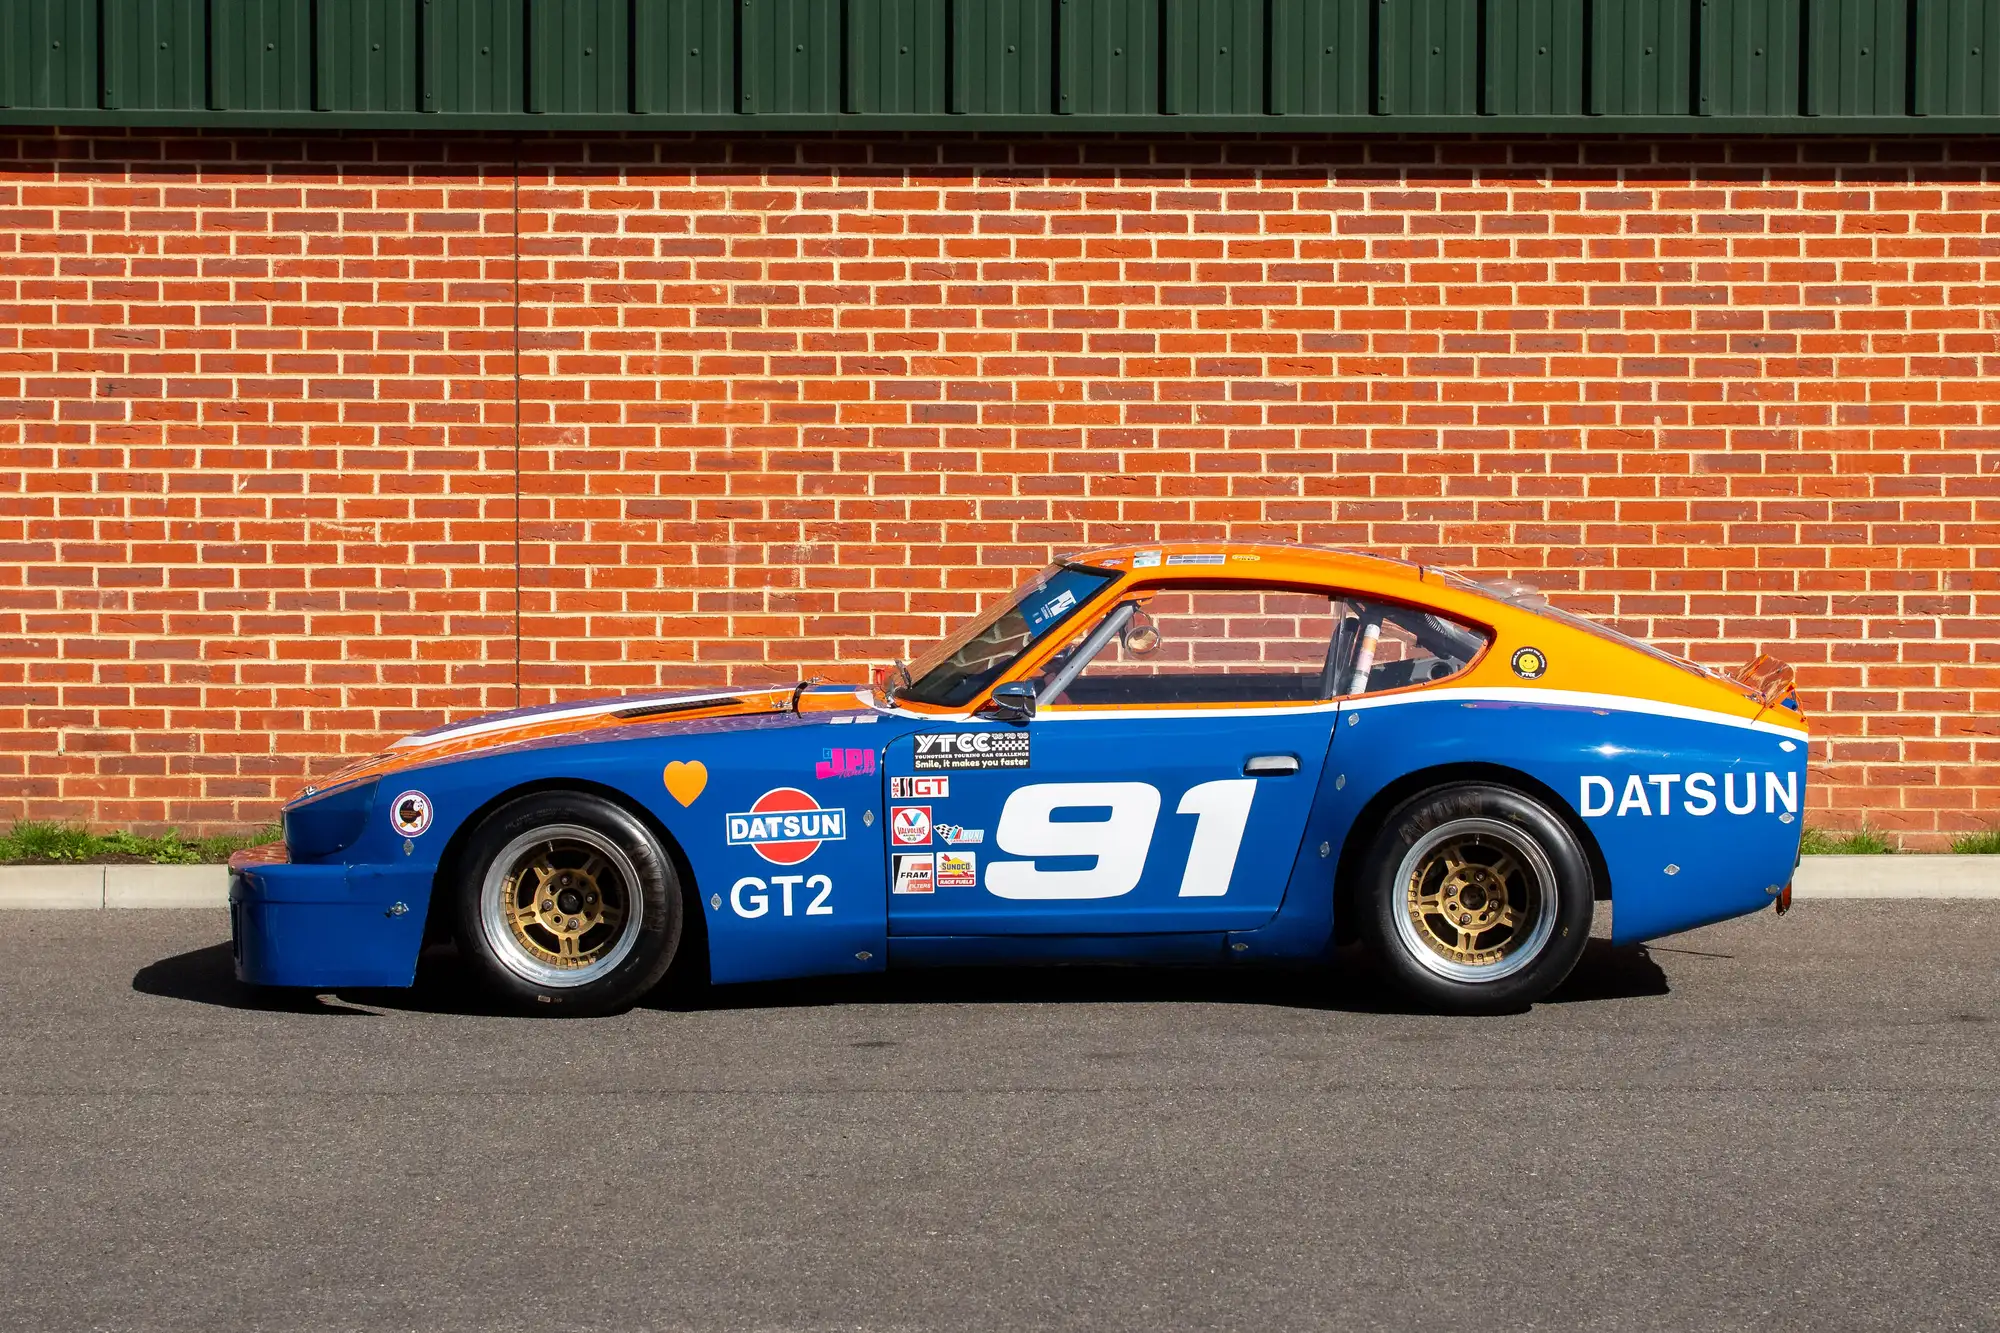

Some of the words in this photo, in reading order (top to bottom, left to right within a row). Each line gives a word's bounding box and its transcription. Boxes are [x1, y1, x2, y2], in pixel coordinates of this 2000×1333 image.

[914, 732, 991, 753] YTCC
[915, 760, 942, 769] Smile,
[943, 759, 951, 768] it
[952, 759, 980, 767] makes
[982, 759, 999, 769] you
[1000, 758, 1029, 767] faster
[914, 778, 947, 795] GT
[1580, 771, 1798, 817] DATSUN
[731, 813, 841, 840] DATSUN
[897, 826, 926, 835] VALVOLINE
[984, 779, 1257, 899] 91
[900, 871, 929, 879] FRAM
[942, 862, 971, 871] SUNOCO
[730, 874, 833, 919] GT2
